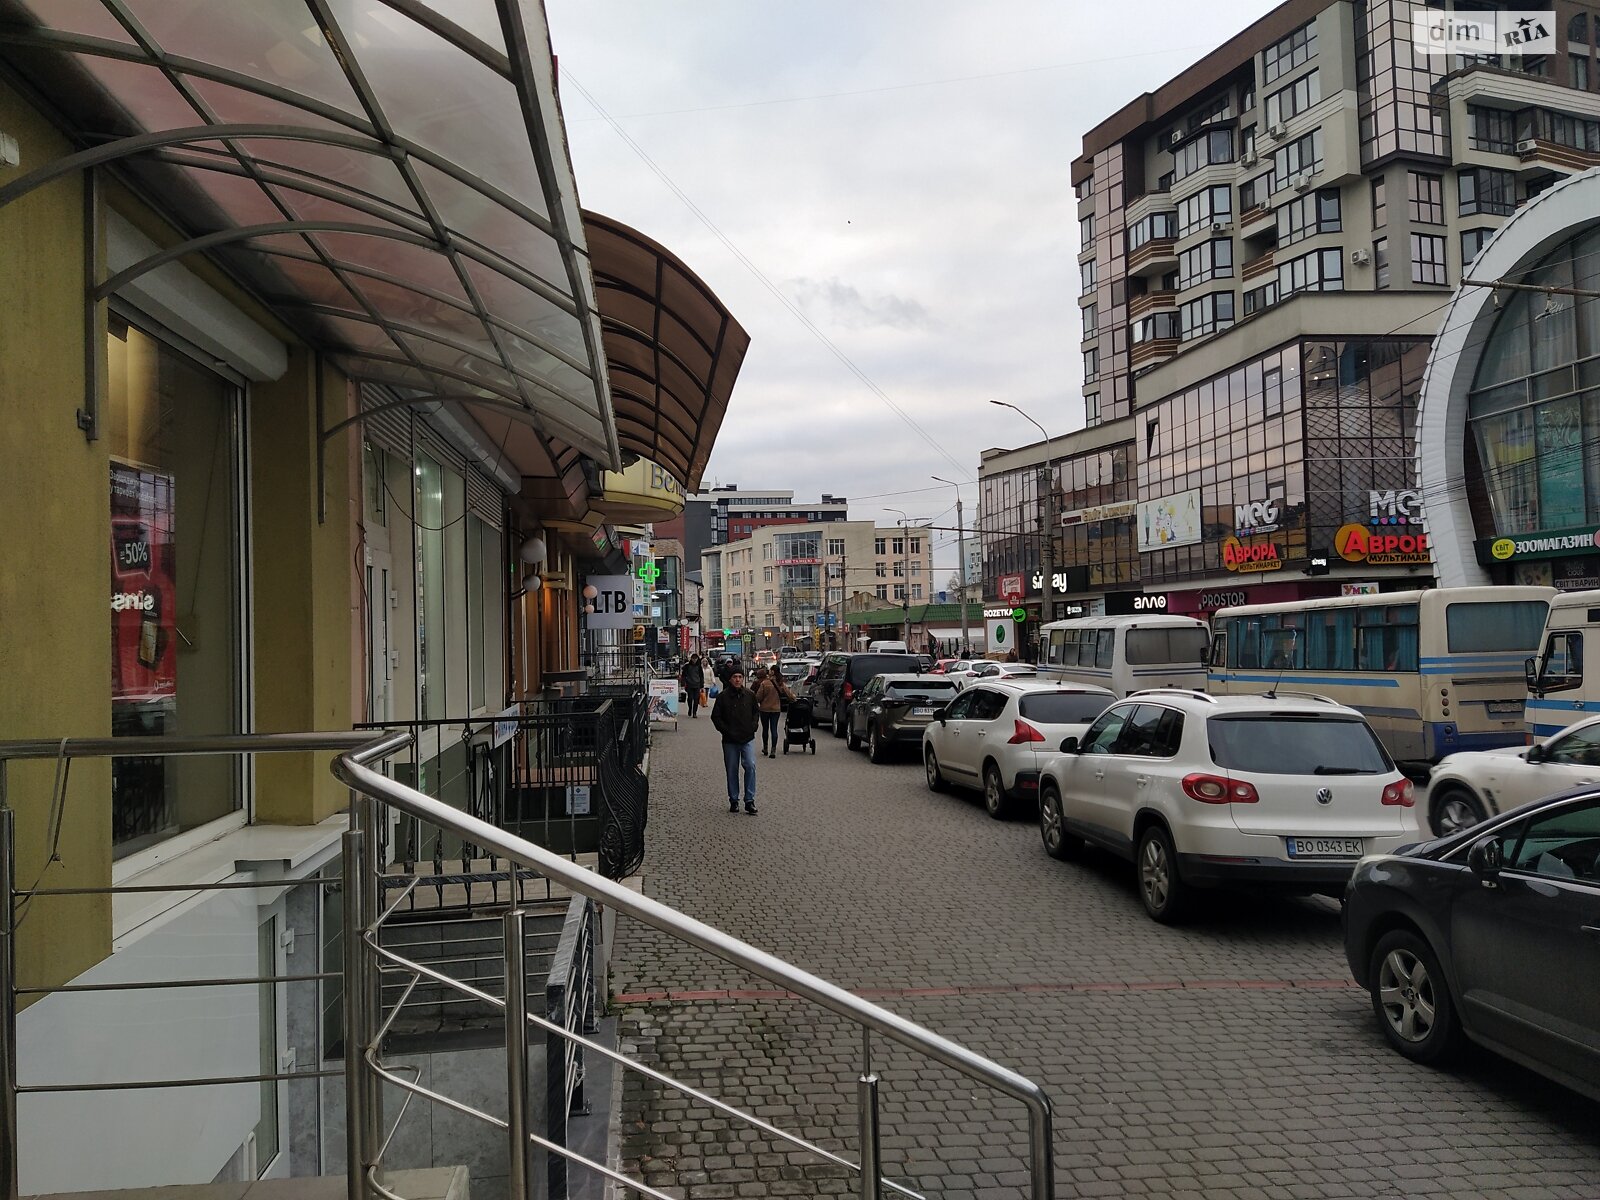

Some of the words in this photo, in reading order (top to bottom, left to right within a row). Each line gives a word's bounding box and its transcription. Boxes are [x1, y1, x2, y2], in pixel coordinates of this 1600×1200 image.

[1515, 533, 1595, 554] ЗООМАГАЗИН
[593, 590, 627, 614] LTB
[1203, 592, 1246, 607] PROSTOR
[984, 608, 1014, 618] ROZETKA
[1296, 841, 1314, 853] BO
[1316, 841, 1343, 853] 0343
[1345, 841, 1361, 853] EK
